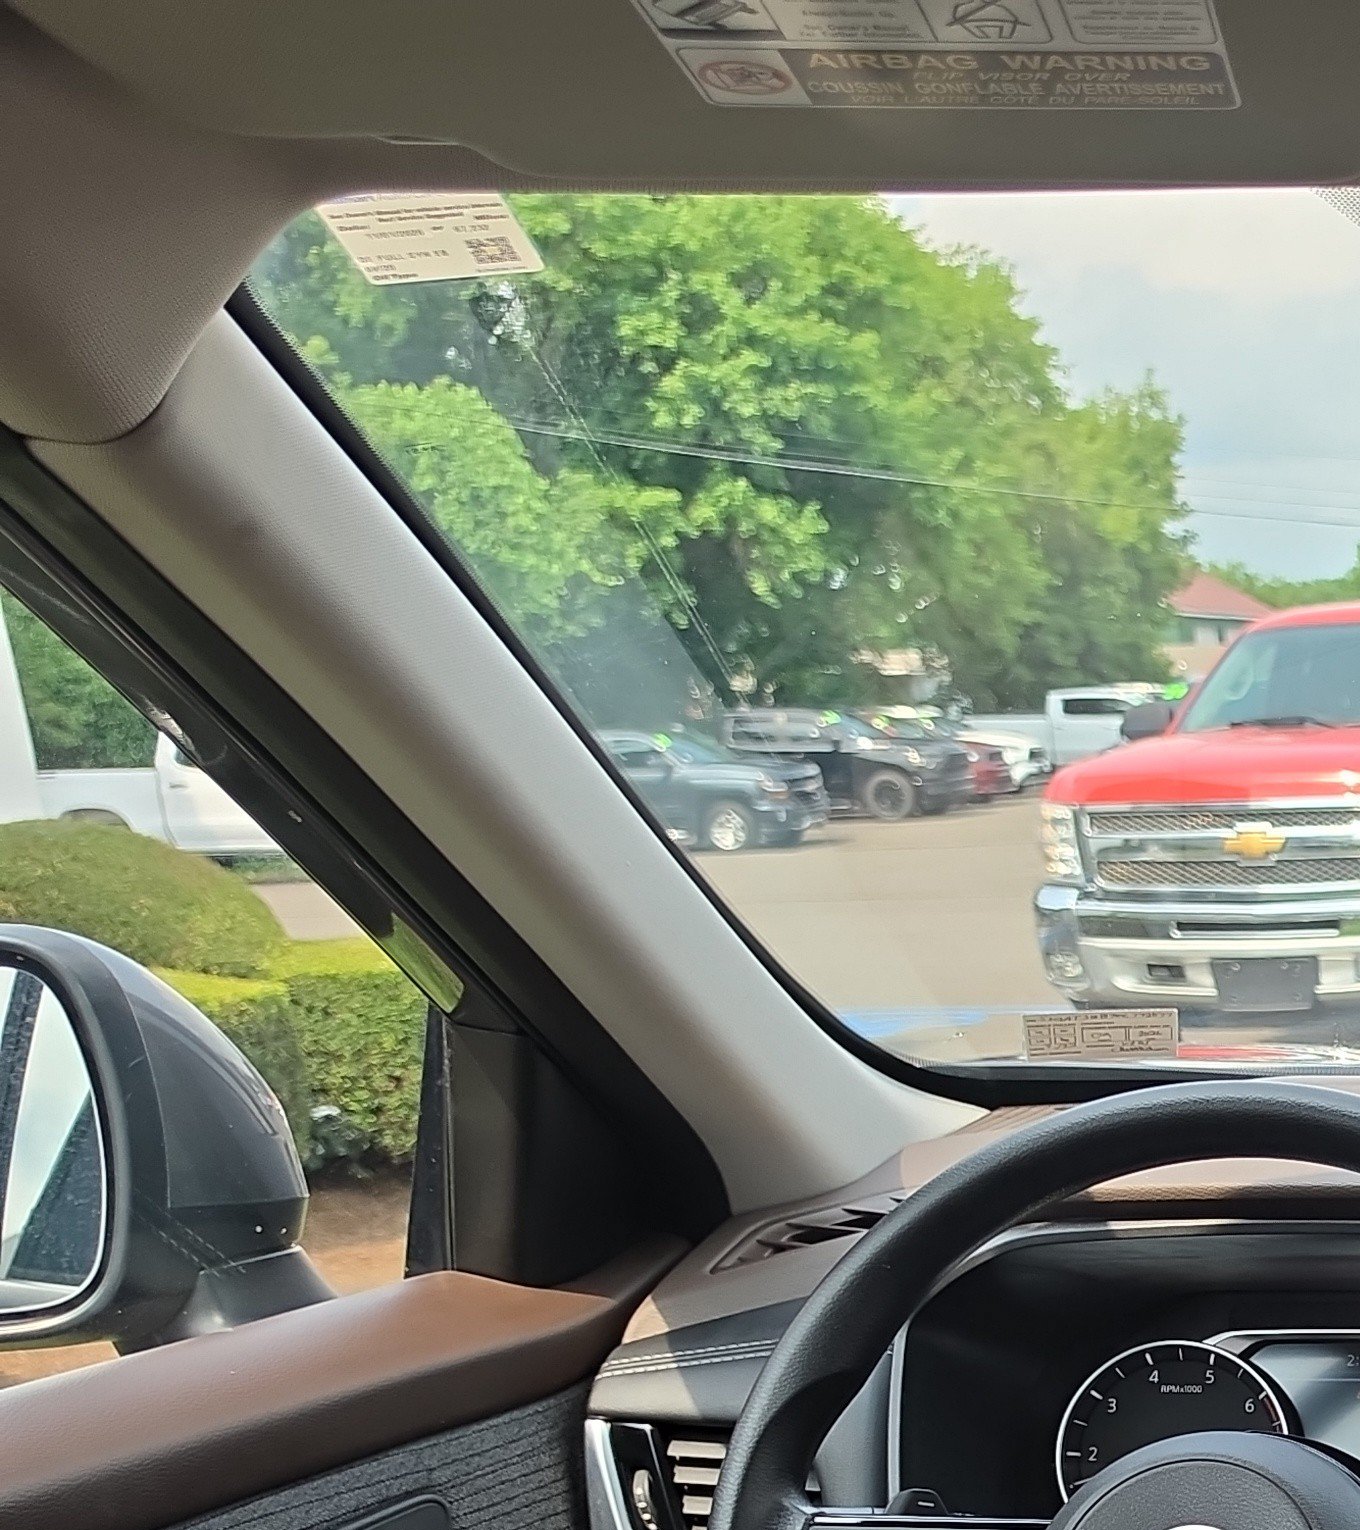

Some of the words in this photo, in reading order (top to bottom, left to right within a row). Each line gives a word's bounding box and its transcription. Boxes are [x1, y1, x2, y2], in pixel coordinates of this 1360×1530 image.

[809, 53, 979, 69] AIRBAG
[1000, 54, 1211, 71] WARNING
[978, 72, 1050, 80] VISOR
[1064, 72, 1131, 81] OVER
[807, 81, 904, 94] COUSSIN
[914, 82, 1045, 96] GONFLABLE
[1055, 82, 1225, 96] AVERTISSEMENT
[1148, 1369, 1159, 1384] 4
[1205, 1369, 1215, 1384] 5
[1160, 1384, 1203, 1394] RPMx1000
[1106, 1398, 1117, 1413] 3
[1244, 1398, 1255, 1413] 6
[1088, 1446, 1098, 1462] 2
